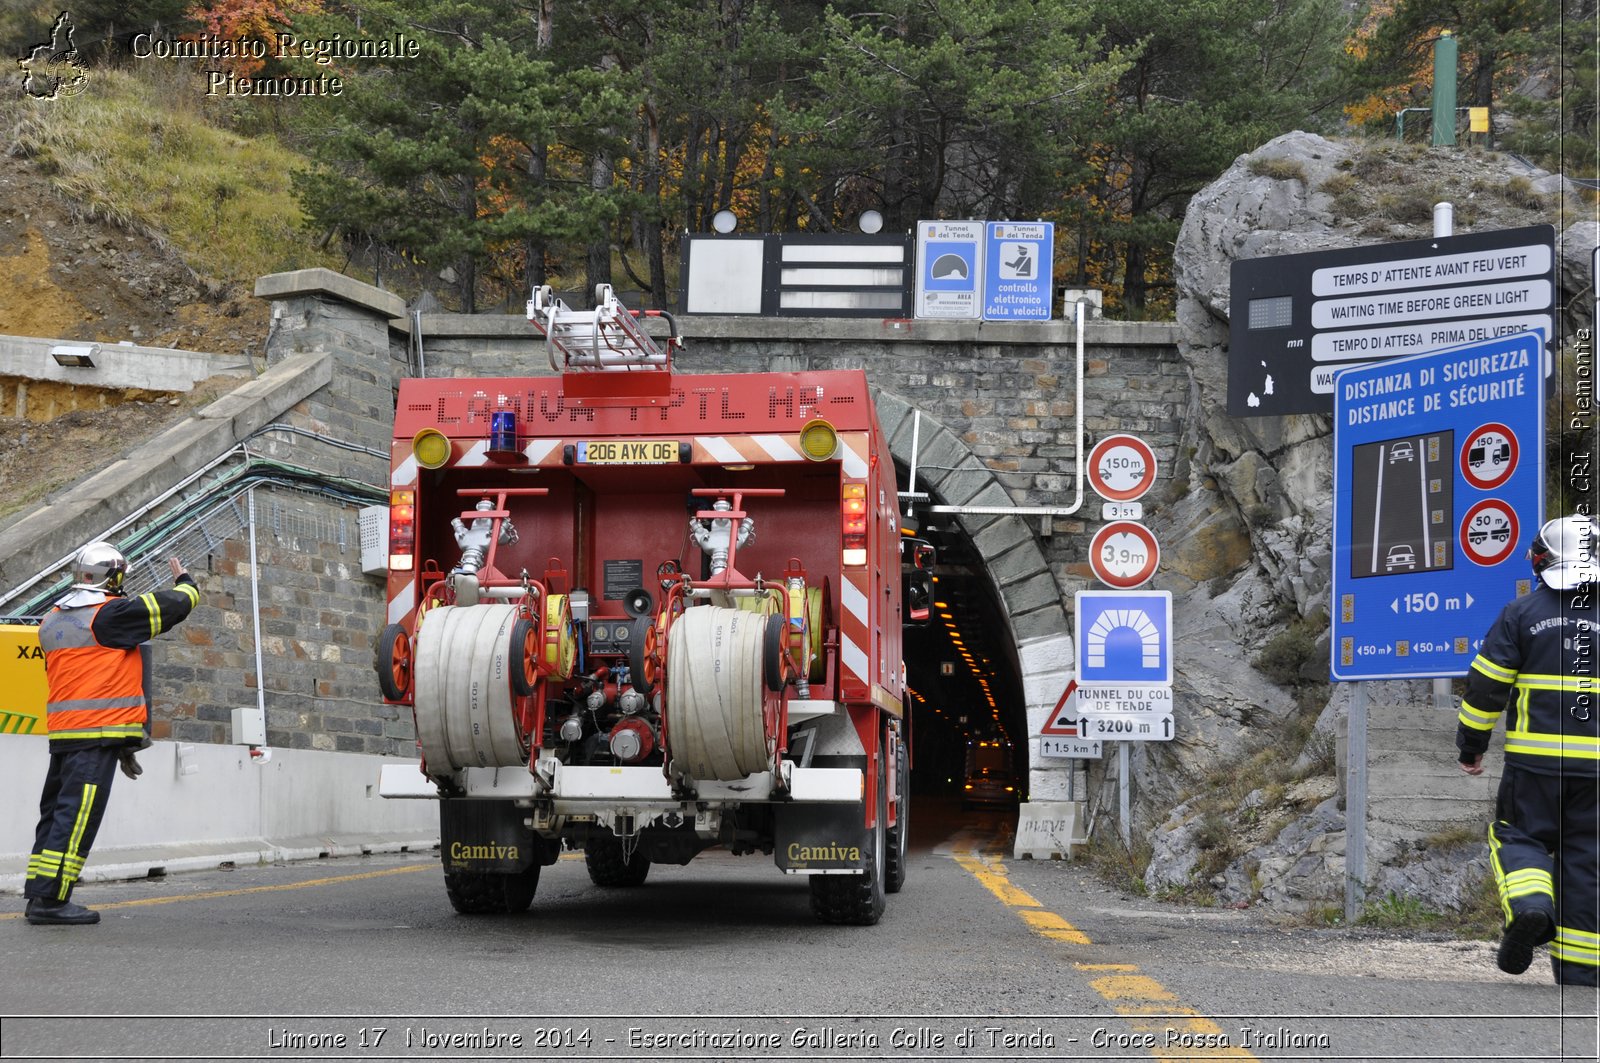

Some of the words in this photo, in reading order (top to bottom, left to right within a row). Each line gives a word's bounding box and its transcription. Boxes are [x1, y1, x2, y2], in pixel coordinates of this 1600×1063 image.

[1333, 272, 1368, 287] TEMPS
[1385, 265, 1432, 282] ATTENTE
[1435, 262, 1470, 277] AVANT
[1472, 258, 1495, 272] FEU
[1497, 255, 1527, 270] VERT
[998, 283, 1038, 292] controllo
[994, 295, 1041, 304] elettronico
[1331, 304, 1375, 320] WAITING
[1378, 301, 1404, 316] TIME
[1407, 297, 1450, 312] BEFORE
[1453, 293, 1492, 308] GREEN
[1495, 290, 1529, 304] LIGHT
[987, 306, 1009, 316] della
[1013, 306, 1048, 316] velocità
[1287, 339, 1304, 348] mn
[1333, 338, 1368, 352] TEMPO
[1371, 338, 1382, 349] DI
[1384, 333, 1423, 348] ATTESA
[1431, 329, 1466, 344] PRIMA
[1469, 328, 1489, 341] DEL
[1345, 372, 1412, 401] DISTANZA
[1420, 367, 1435, 387] DI
[1443, 349, 1529, 383] SICUREZZA
[1349, 398, 1416, 426] DISTANCE
[1424, 393, 1442, 413] DE
[1450, 375, 1525, 407] SÉCURITÉ
[1476, 437, 1493, 447] 150
[589, 444, 616, 460] 206
[621, 444, 648, 460] AYK
[653, 444, 671, 460] 06
[1476, 516, 1491, 526] 50
[1404, 592, 1439, 613] 150
[1445, 598, 1460, 611] m
[1363, 646, 1376, 656] 50
[1420, 642, 1433, 652] 50
[1078, 690, 1122, 700] TUNNEL
[1128, 690, 1142, 700] DU
[1149, 690, 1170, 700] COL
[1096, 702, 1110, 710] DE
[1116, 702, 1152, 711] TENDE
[1097, 720, 1133, 733] 3200
[1138, 722, 1150, 733] m
[1074, 745, 1088, 753] km
[451, 840, 519, 860] Camiva
[787, 841, 860, 861] Camiva
